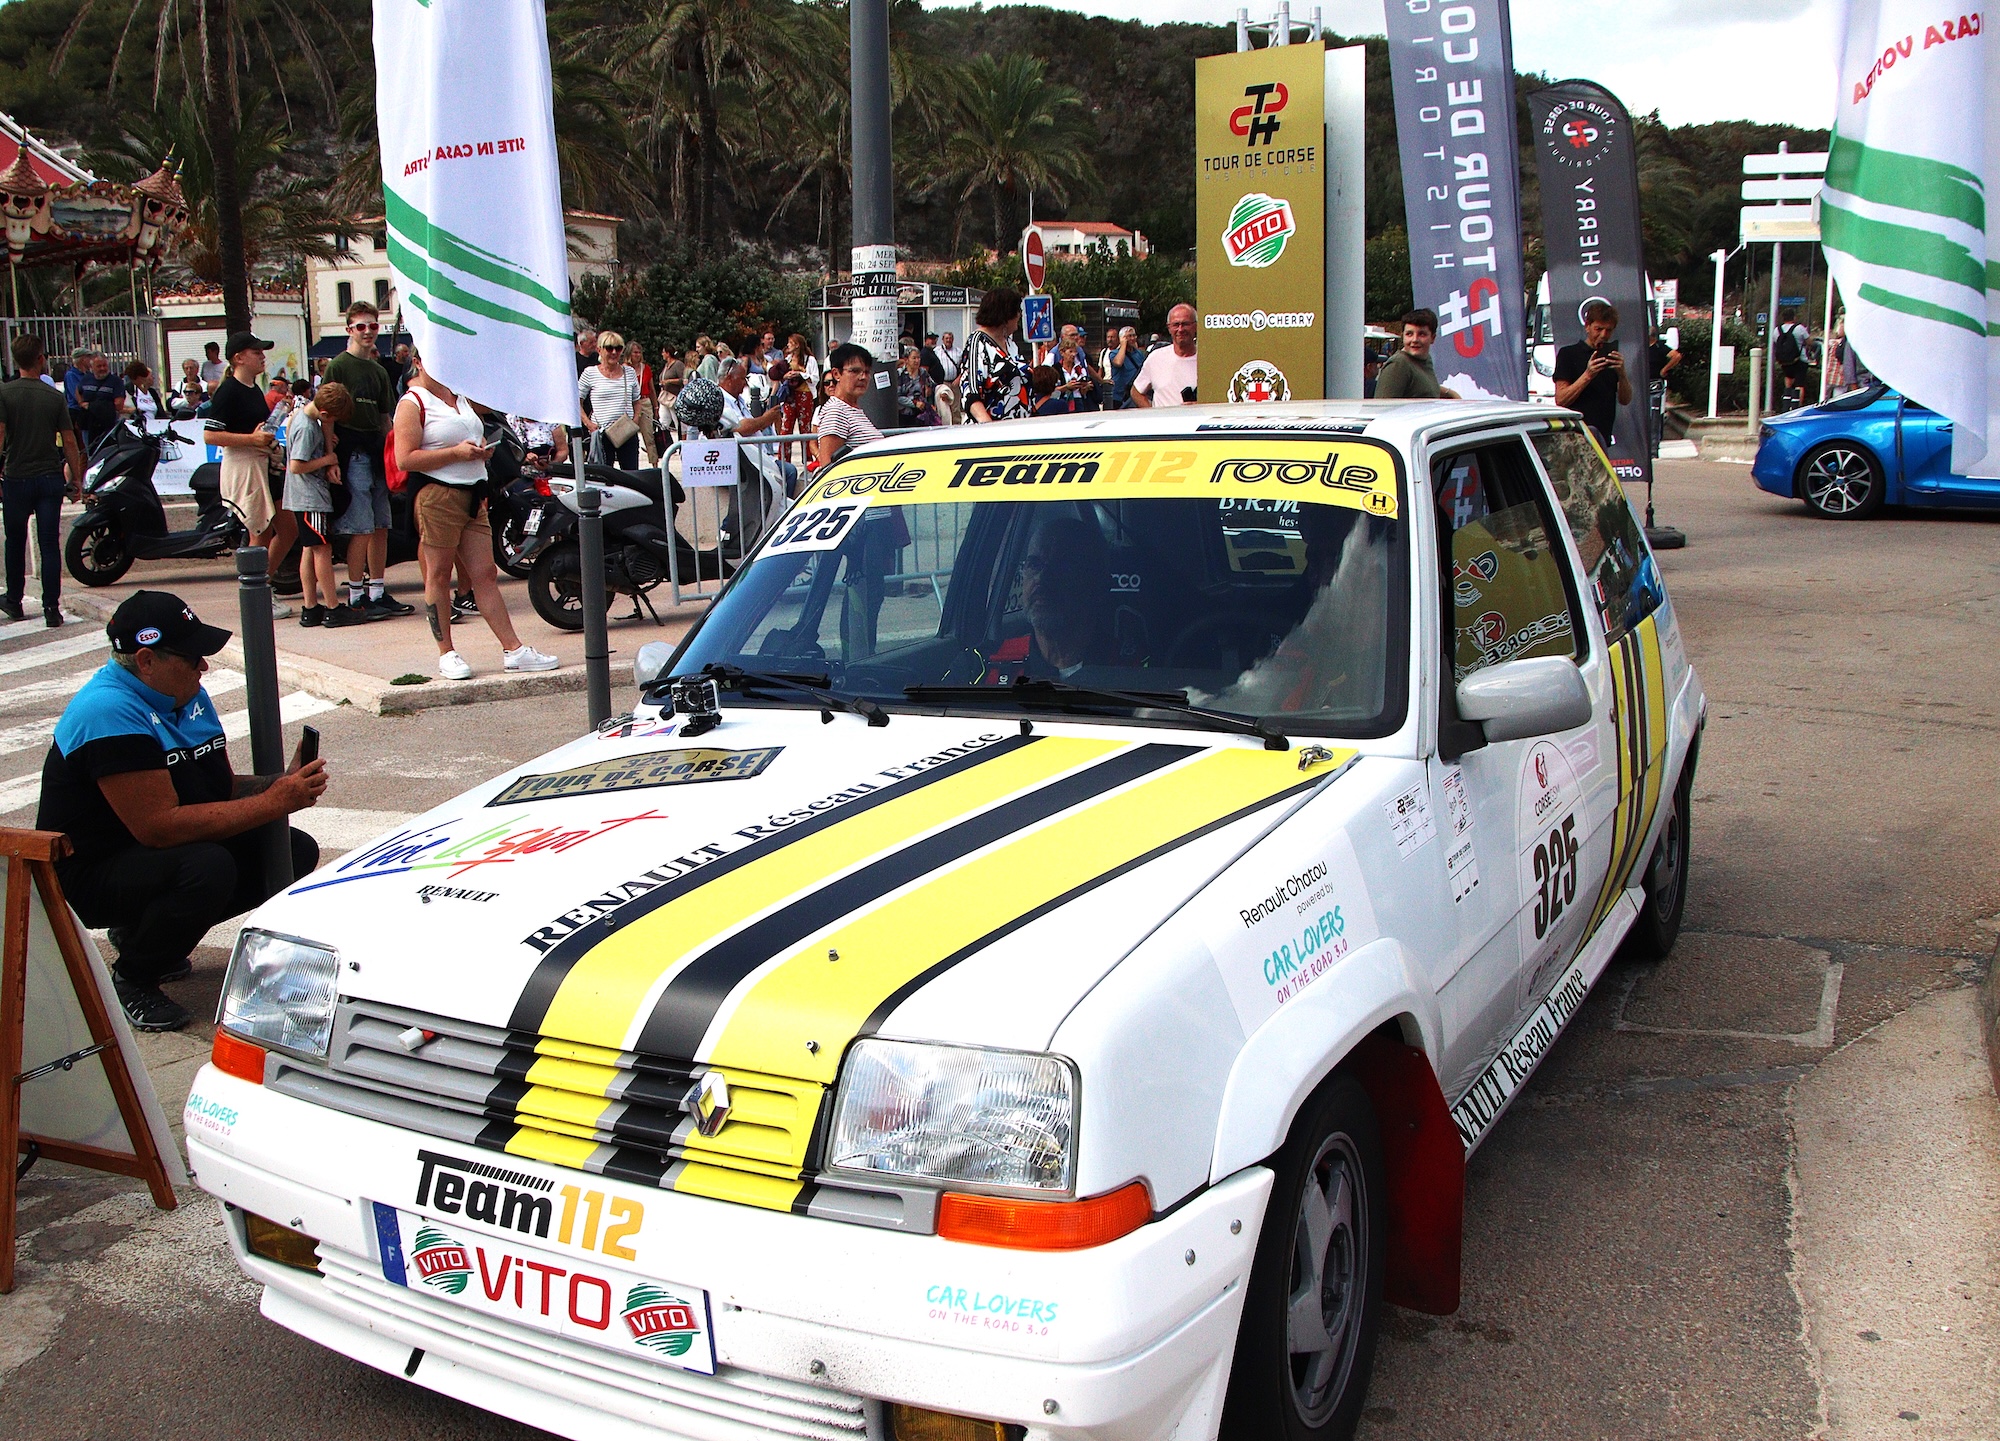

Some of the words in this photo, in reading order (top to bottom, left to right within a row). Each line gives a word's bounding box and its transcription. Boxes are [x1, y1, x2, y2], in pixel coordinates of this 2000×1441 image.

[1204, 155, 1239, 171] TOUR
[1245, 153, 1261, 167] DE
[1268, 147, 1314, 164] CORSE
[868, 260, 877, 269] 24
[1206, 316, 1248, 327] BENSON
[1268, 314, 1313, 326] CHERRY
[806, 463, 926, 504] roole
[947, 452, 1104, 488] Team
[1102, 451, 1198, 483] 112
[1210, 453, 1378, 493] roole
[1372, 495, 1386, 507] H
[770, 505, 858, 547] 325
[514, 773, 596, 793] TOUR
[601, 769, 645, 783] DE
[645, 752, 762, 779] CORSE
[621, 755, 670, 769] 325
[520, 843, 730, 956] RENAULT
[732, 782, 881, 841] Réseau
[876, 733, 1004, 781] France
[415, 885, 500, 903] RENAULT
[1240, 886, 1290, 928] Renault
[1286, 860, 1328, 897] Chatou
[1534, 813, 1578, 939] 325
[1297, 884, 1326, 916] powered
[1324, 882, 1334, 896] by
[1264, 945, 1298, 986] CAR
[1293, 905, 1345, 964] LOVERS
[1277, 985, 1291, 1004] ON
[1291, 969, 1310, 993] THE
[1310, 951, 1333, 977] ROAD
[1334, 938, 1348, 958] 3.0
[1544, 968, 1588, 1030] France
[188, 1093, 203, 1113] CAR
[202, 1100, 238, 1126] LOVERS
[205, 1119, 219, 1130] ROAD
[416, 1149, 554, 1239] Team
[558, 1184, 645, 1261] 112
[387, 1245, 395, 1261] F
[926, 1285, 968, 1312] CAR
[974, 1292, 1059, 1323] LOVERS
[929, 1309, 947, 1320] ON
[954, 1312, 978, 1325] THE
[984, 1317, 1020, 1332] ROAD
[1026, 1324, 1049, 1336] 3.0
